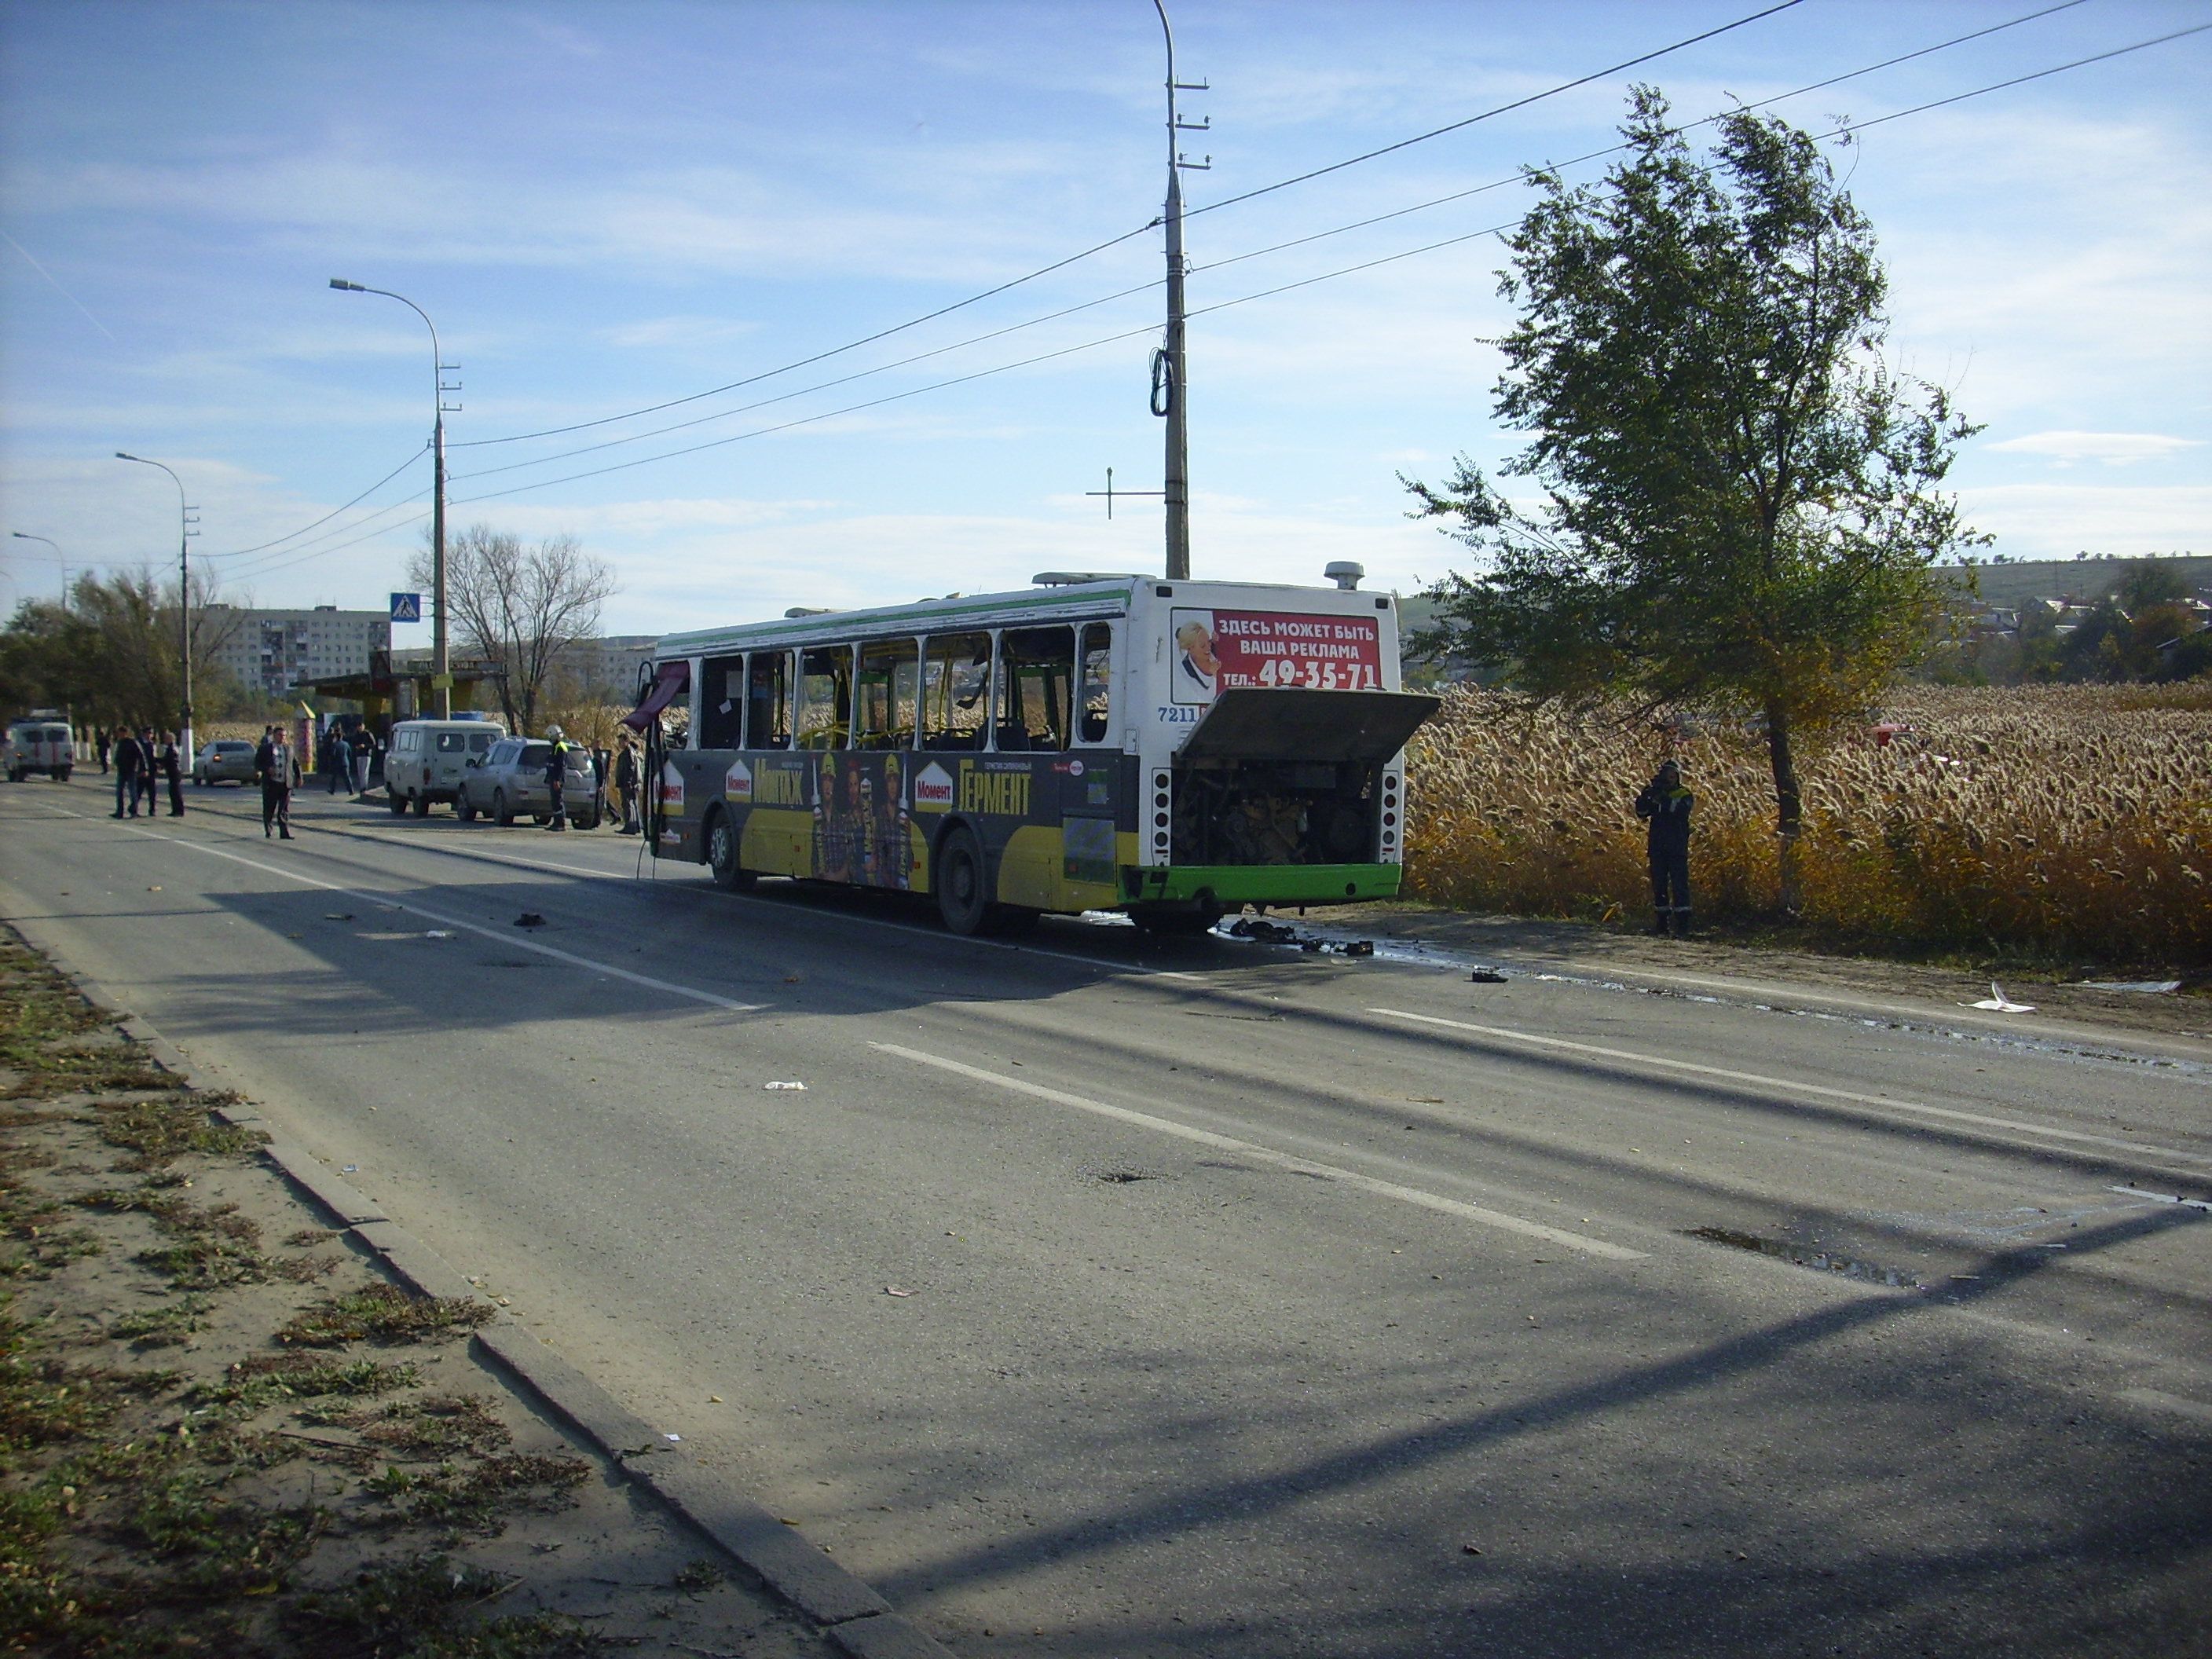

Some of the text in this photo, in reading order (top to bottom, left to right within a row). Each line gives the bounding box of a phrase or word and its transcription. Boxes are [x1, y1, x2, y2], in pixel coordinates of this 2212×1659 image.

[1219, 619, 1374, 641] ЗДЕСЬ МОЖЕТ БЫТЬ
[1240, 640, 1359, 659] ВАША РЕКЛАМА
[1223, 659, 1376, 690] ТЕЛ.: 49-35-71
[1158, 707, 1196, 722] 7211
[917, 781, 950, 800] Момент
[958, 759, 1031, 815] ГЕРМЕНТ
